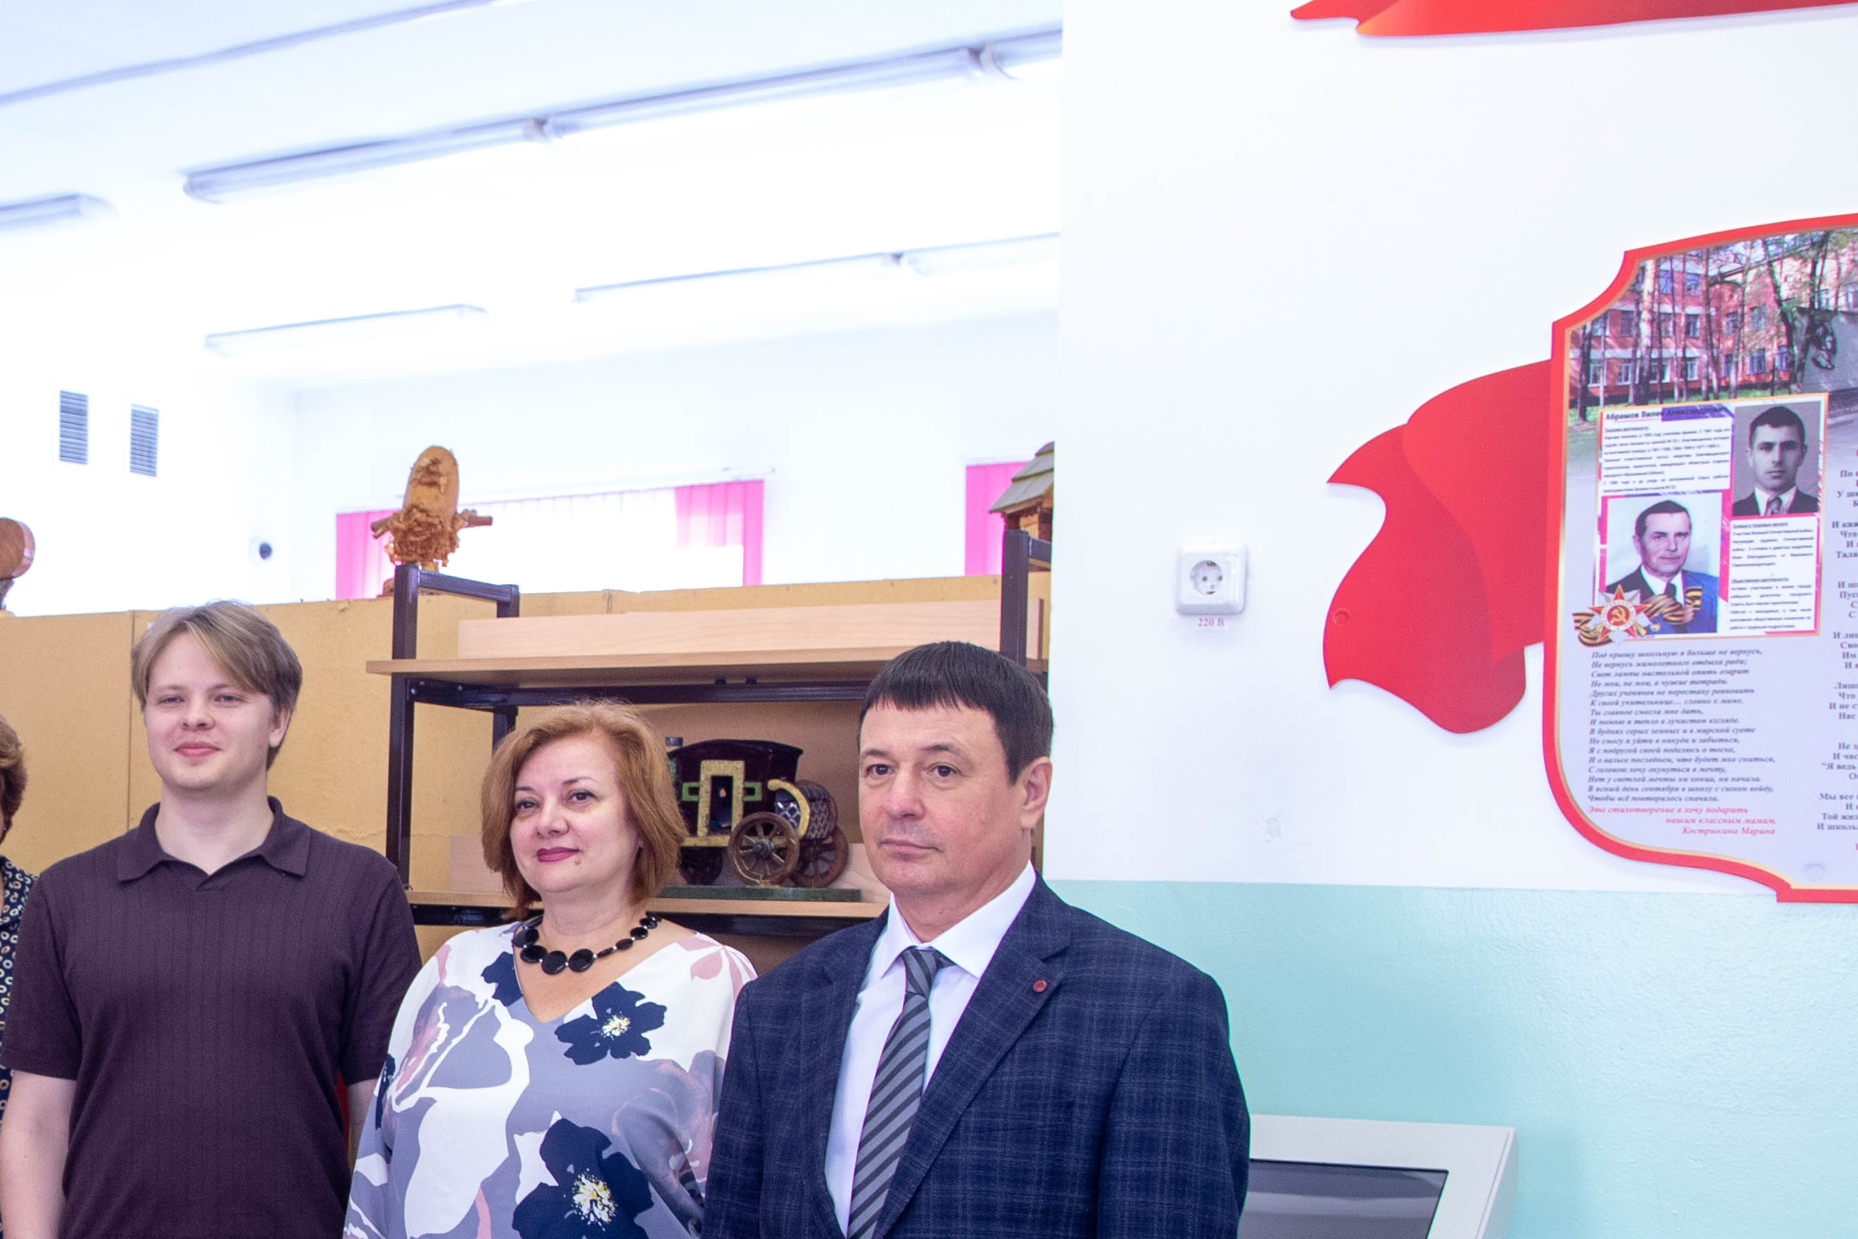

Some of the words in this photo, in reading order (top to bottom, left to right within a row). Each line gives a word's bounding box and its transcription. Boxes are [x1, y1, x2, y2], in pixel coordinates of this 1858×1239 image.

[1606, 412, 1639, 421] Абрамов
[1198, 618, 1214, 627] 220
[1740, 826, 1775, 836] Марина
